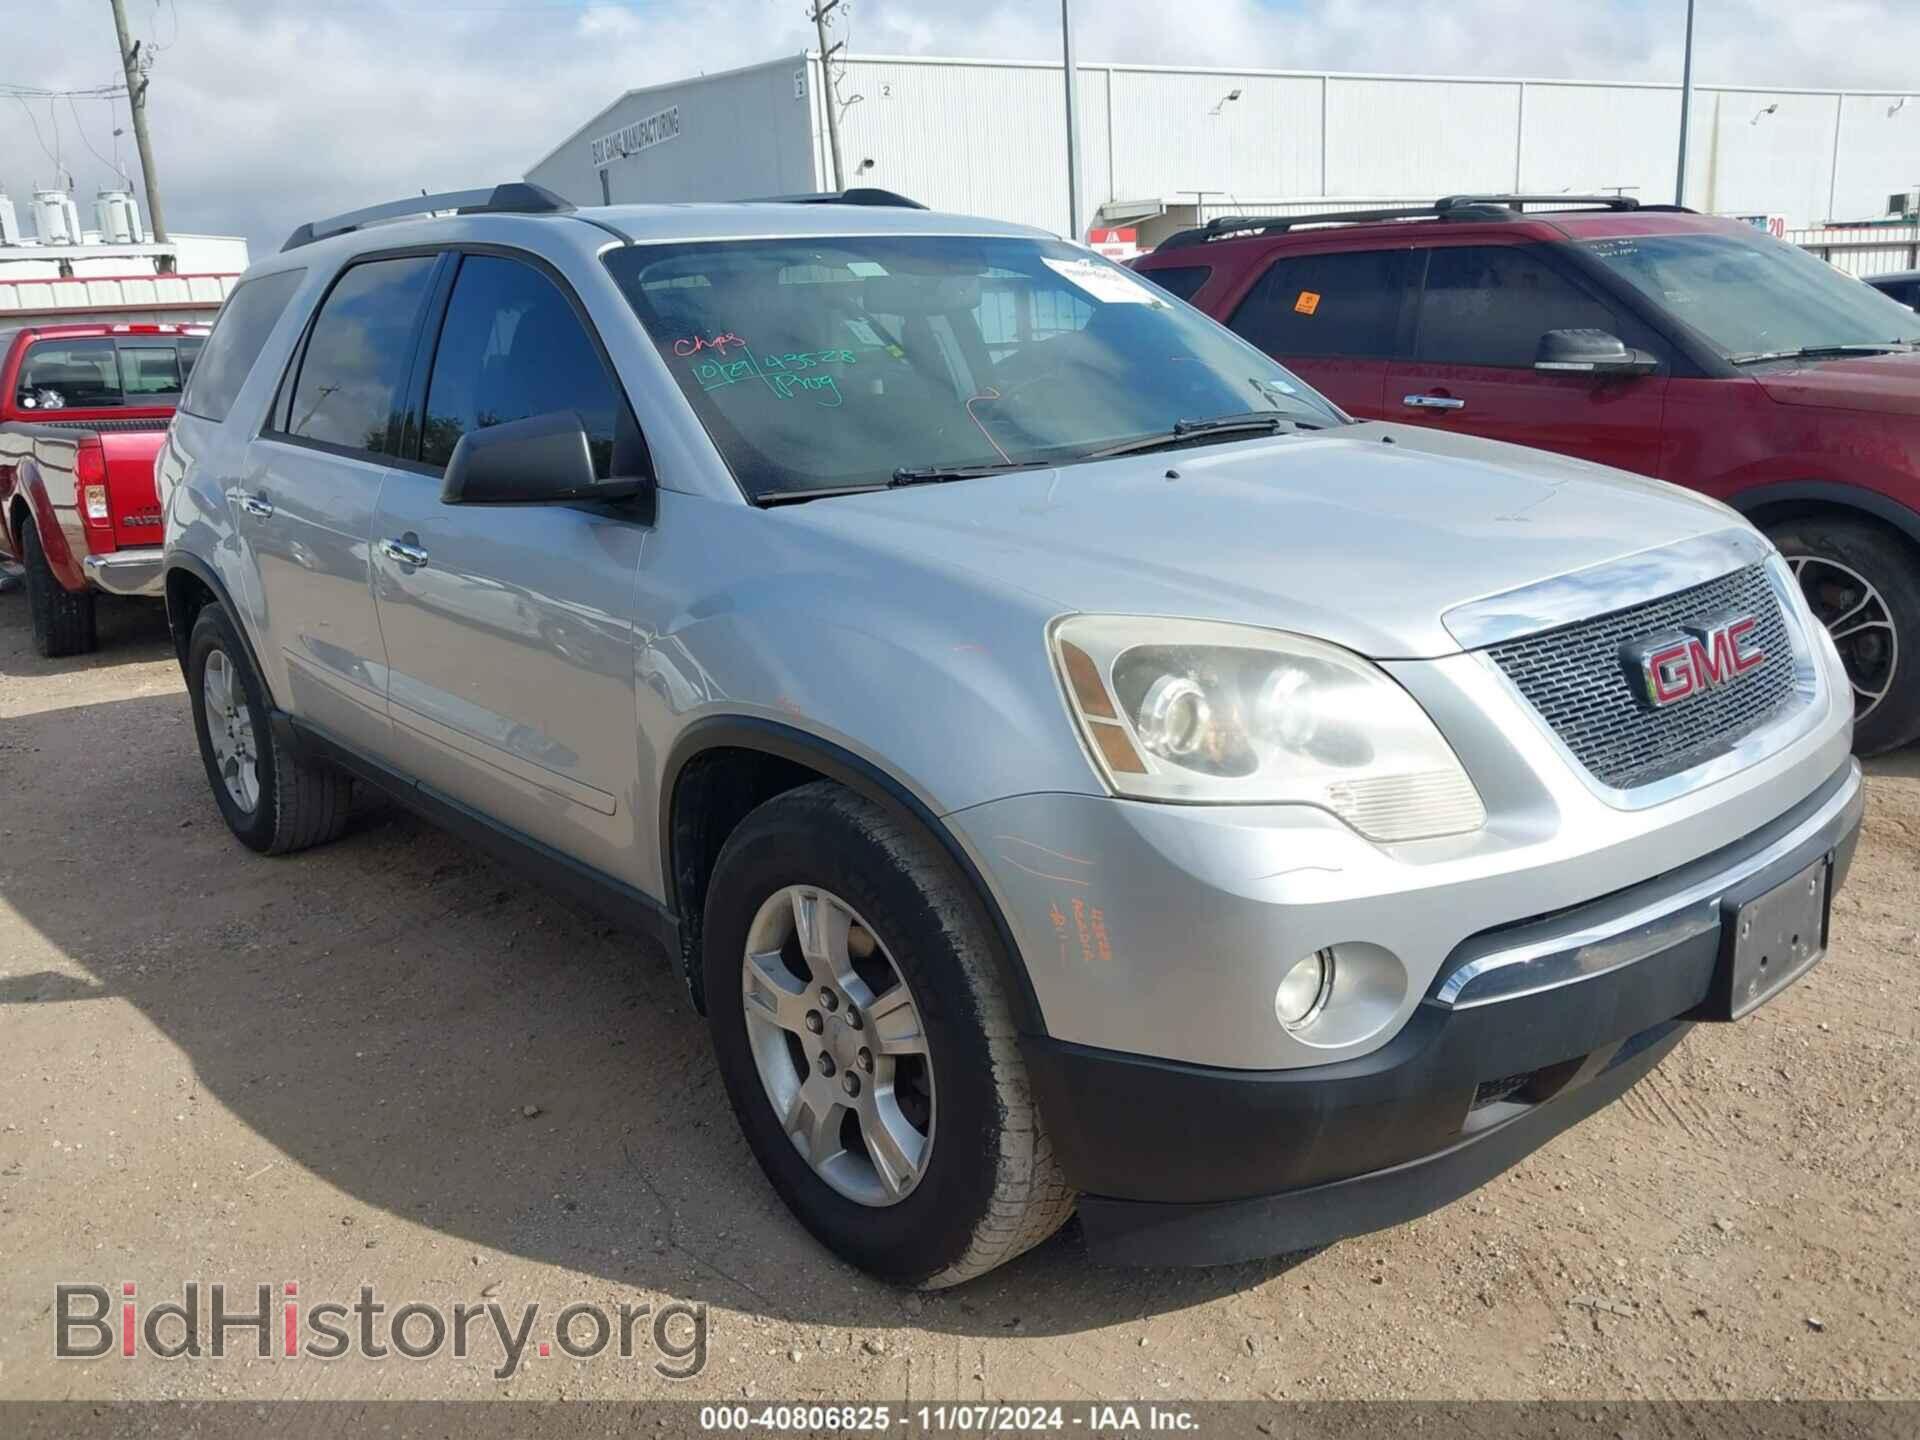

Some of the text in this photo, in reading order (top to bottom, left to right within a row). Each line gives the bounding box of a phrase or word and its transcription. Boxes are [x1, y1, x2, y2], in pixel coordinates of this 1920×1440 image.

[883, 86, 890, 97] 2
[622, 107, 679, 154] MANUFACTURING
[1769, 217, 1784, 239] 20
[1645, 616, 1765, 705] GMC
